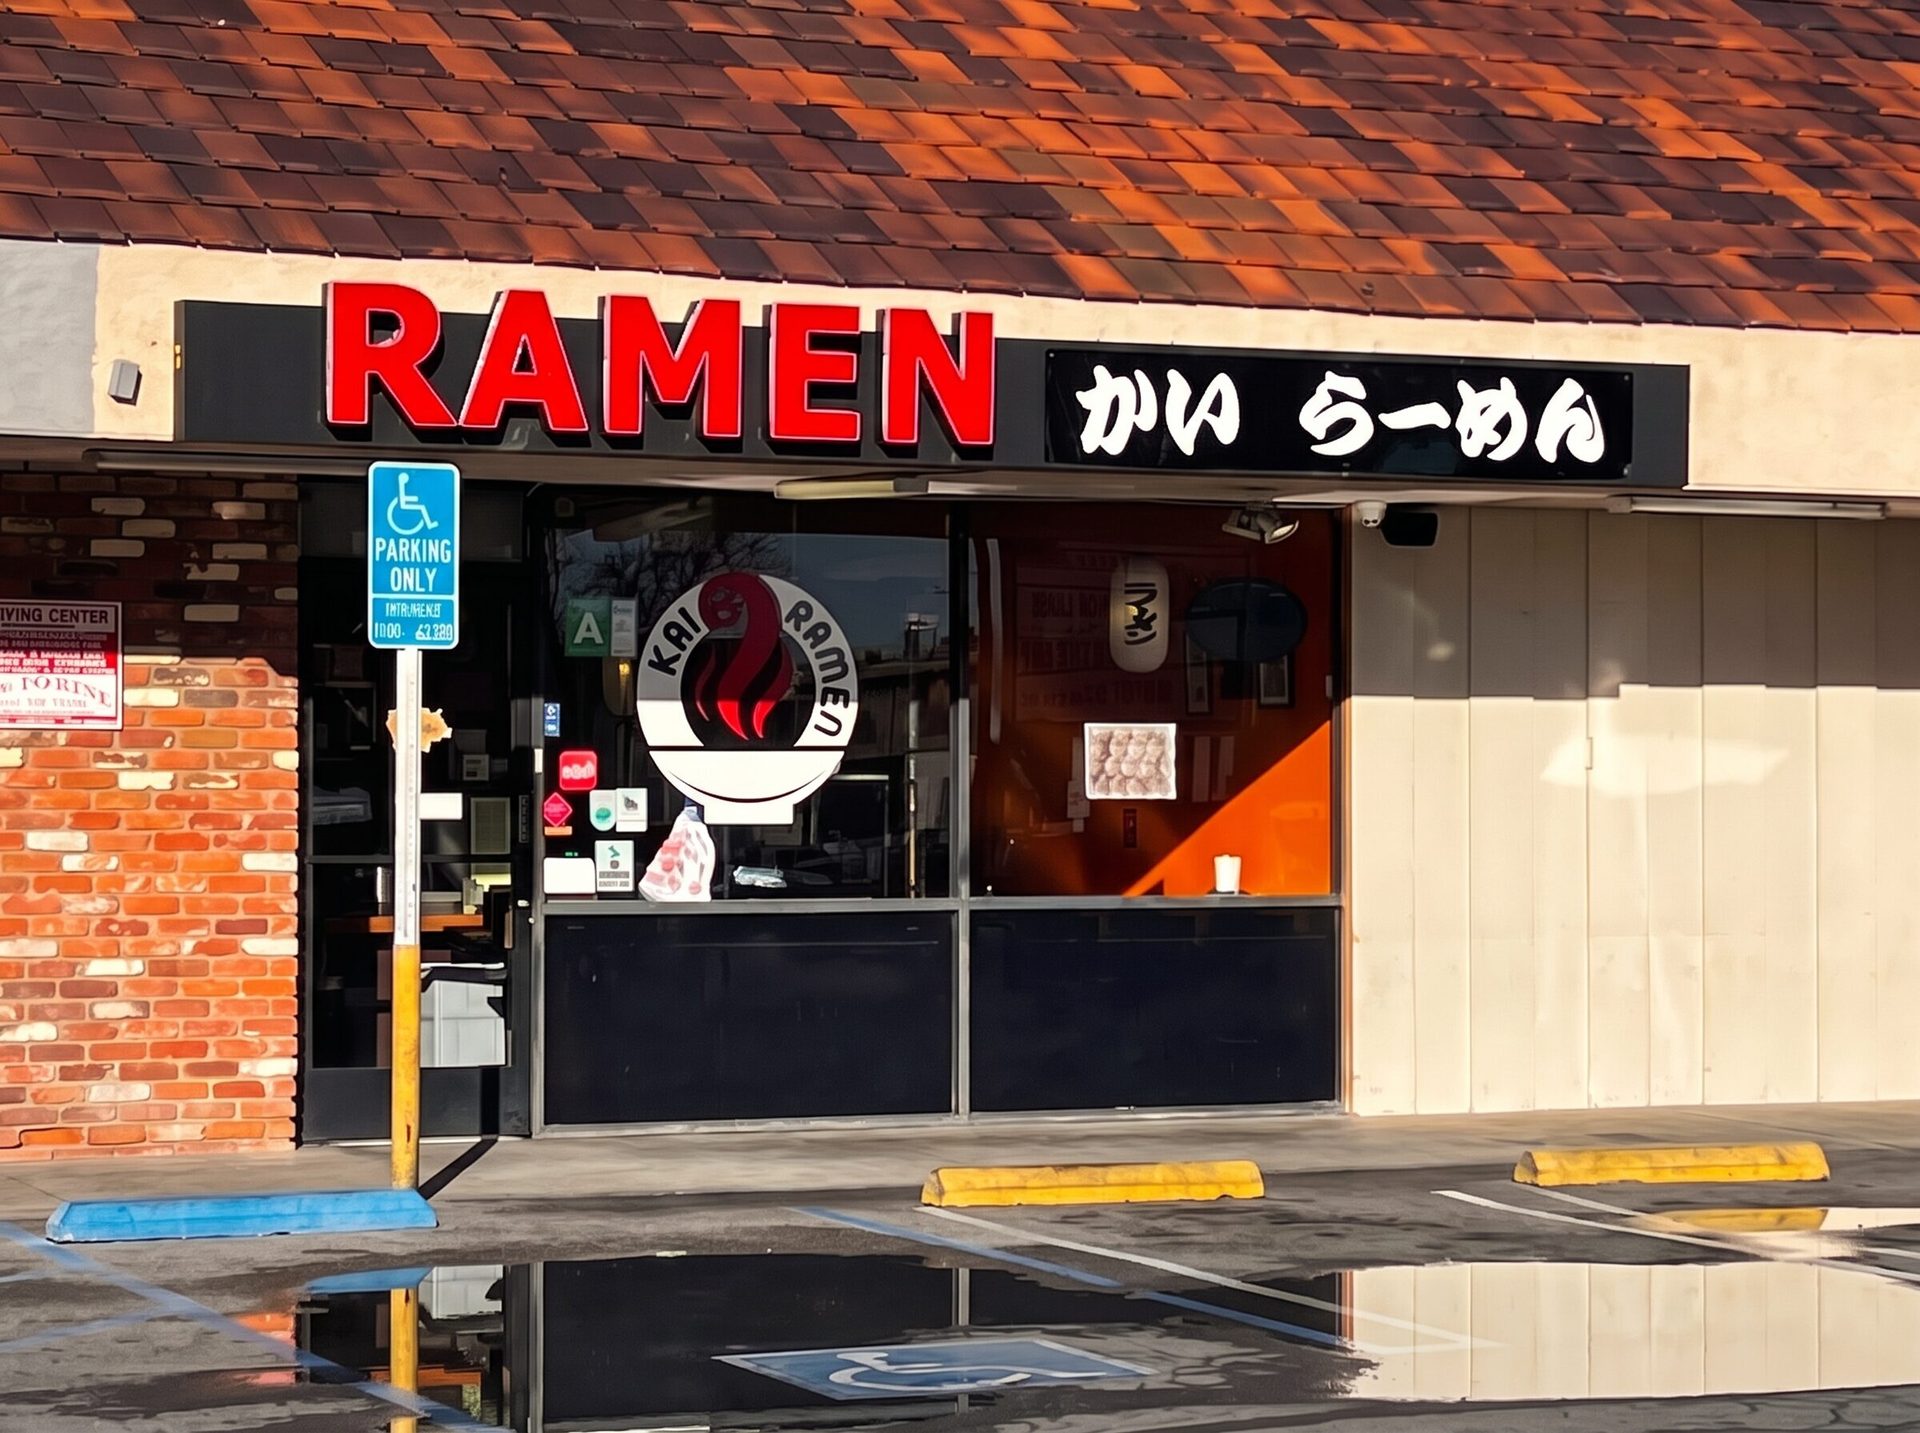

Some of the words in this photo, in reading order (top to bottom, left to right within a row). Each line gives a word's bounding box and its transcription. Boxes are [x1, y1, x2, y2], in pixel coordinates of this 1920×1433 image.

[325, 282, 996, 444] RAMEN
[1076, 364, 1240, 456] かい
[1299, 370, 1606, 463] らーめん
[375, 537, 452, 564] PARKING
[390, 567, 438, 592] ONLY
[0, 607, 43, 624] IVING
[49, 608, 109, 625] CENTER
[573, 611, 604, 645] A
[648, 606, 702, 677] KAI
[784, 600, 850, 738] RAMEN
